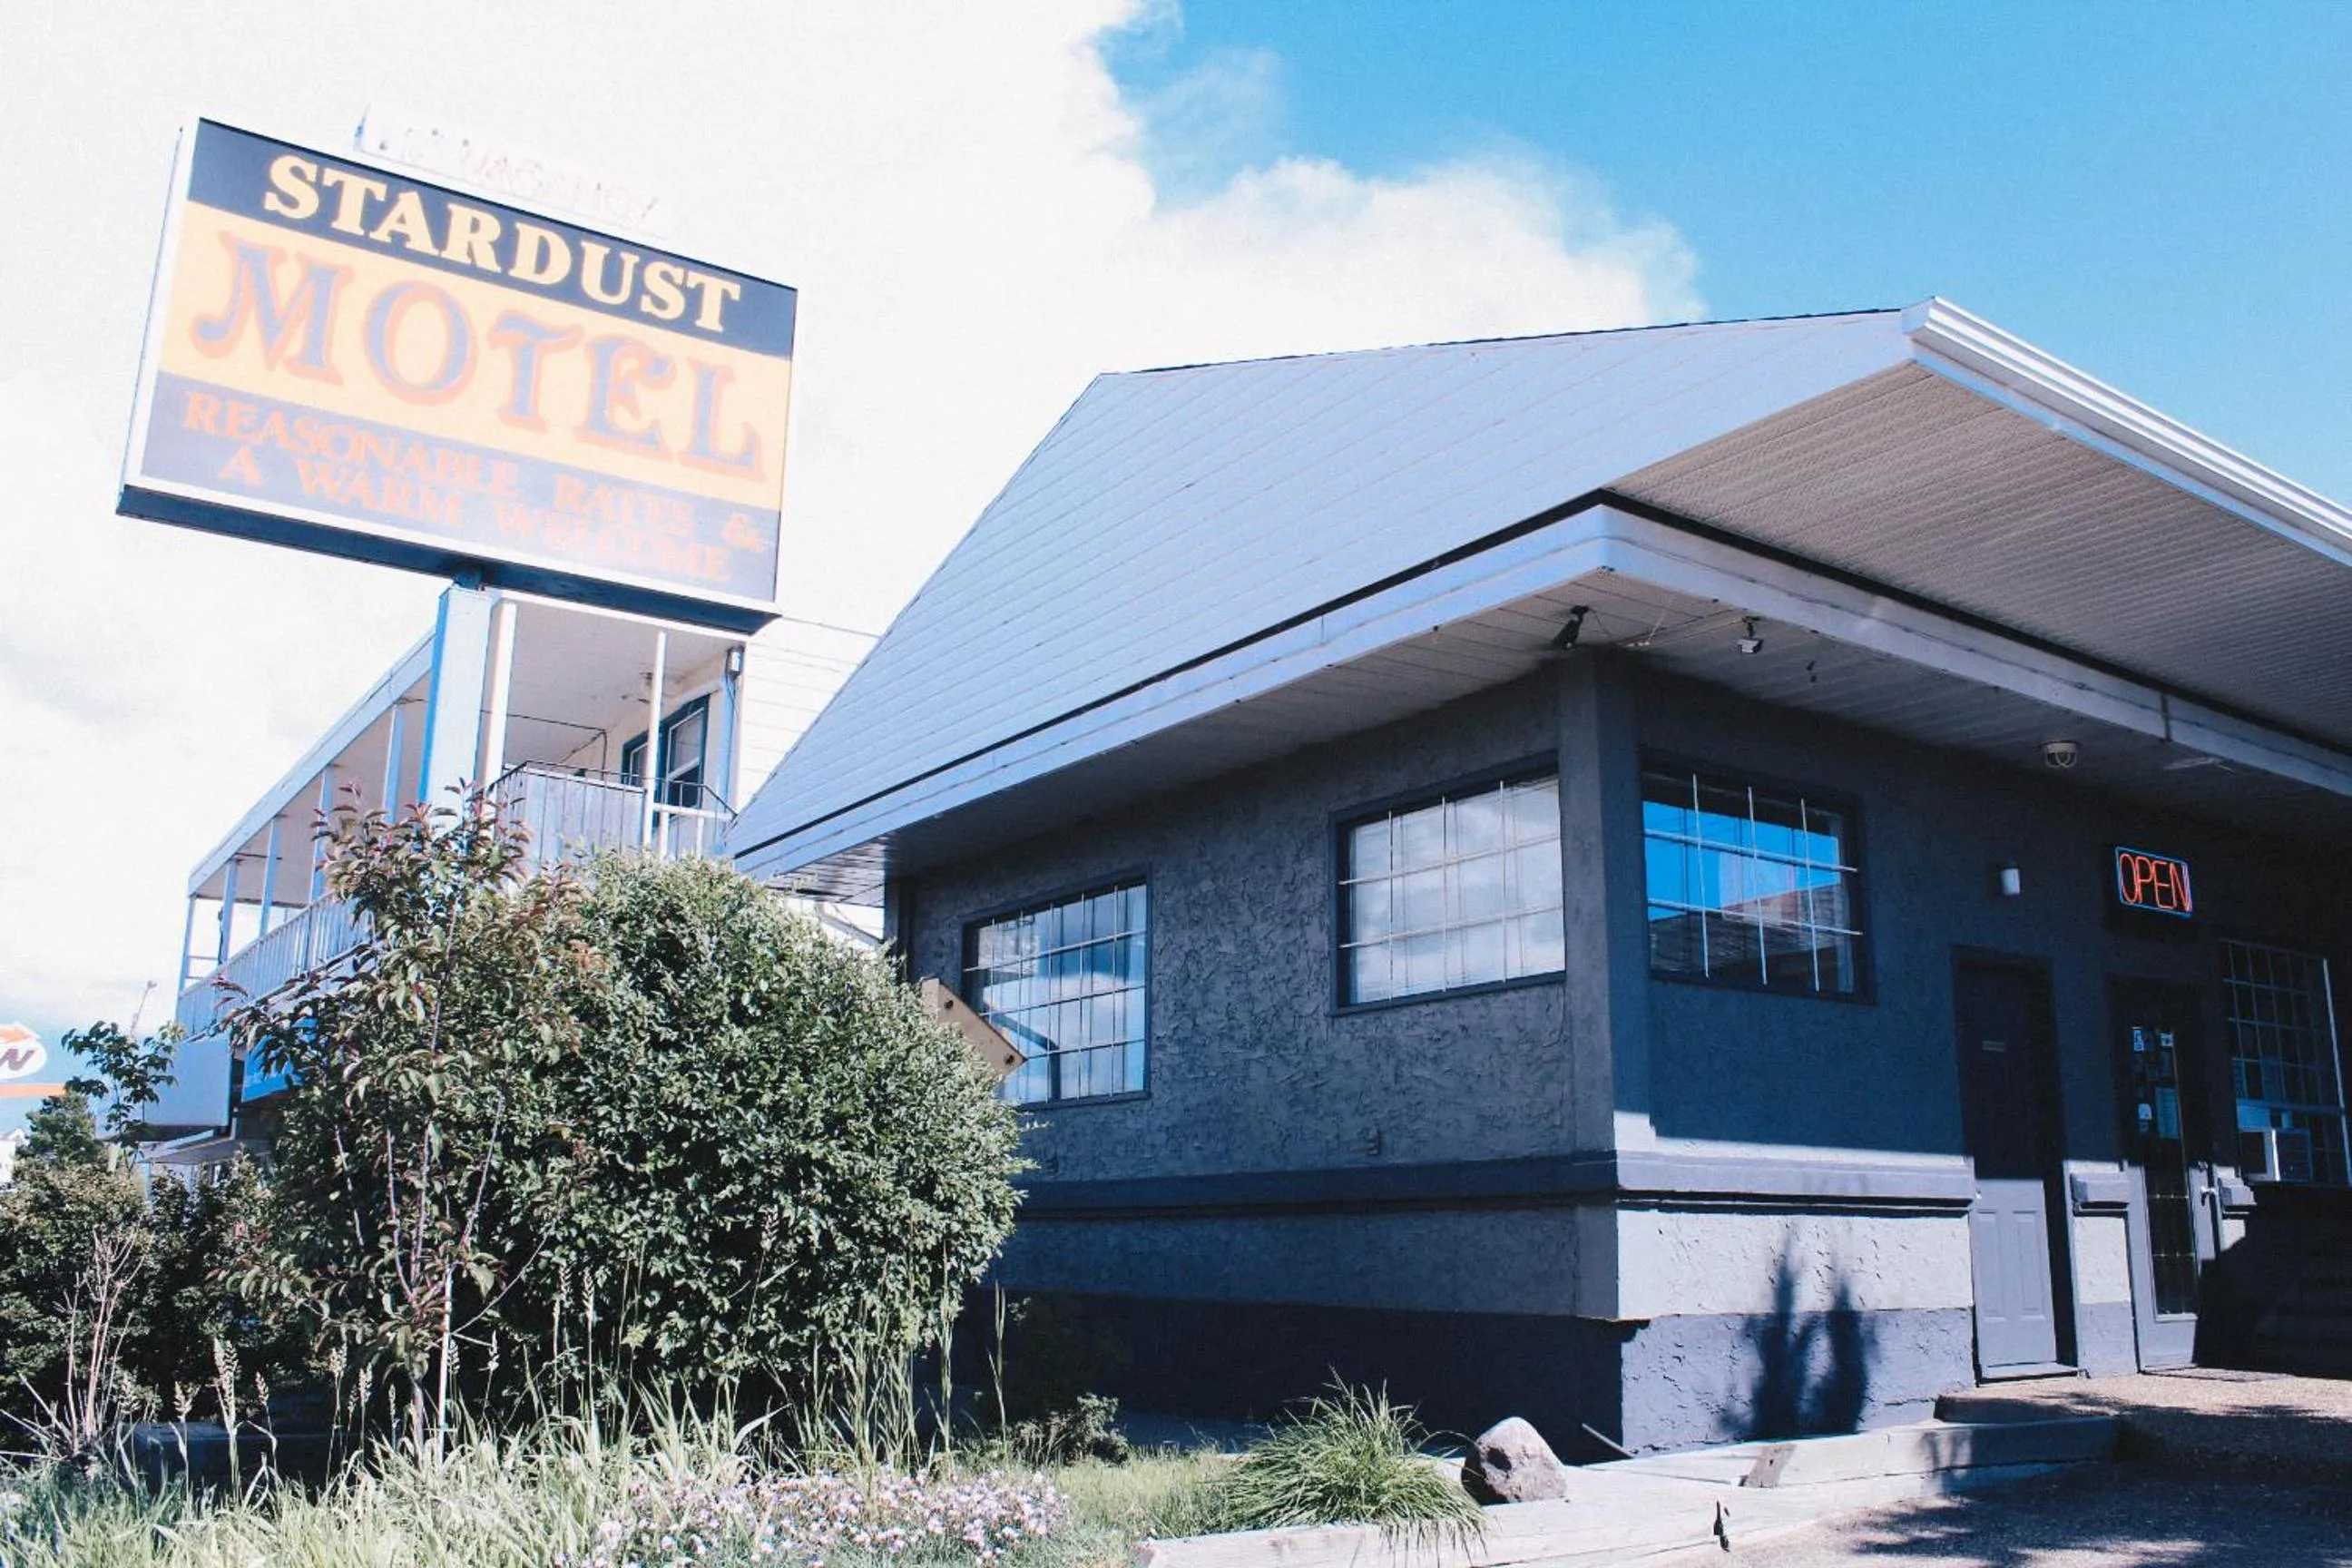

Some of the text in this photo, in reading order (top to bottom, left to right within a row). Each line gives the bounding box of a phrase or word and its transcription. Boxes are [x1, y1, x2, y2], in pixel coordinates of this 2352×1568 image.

[263, 154, 740, 332] STARDUST
[188, 230, 766, 482] MOTEL
[181, 390, 763, 554] REASONABLE RATES &
[217, 444, 732, 583] A WARM WELCOME
[2119, 853, 2192, 912] OPEN
